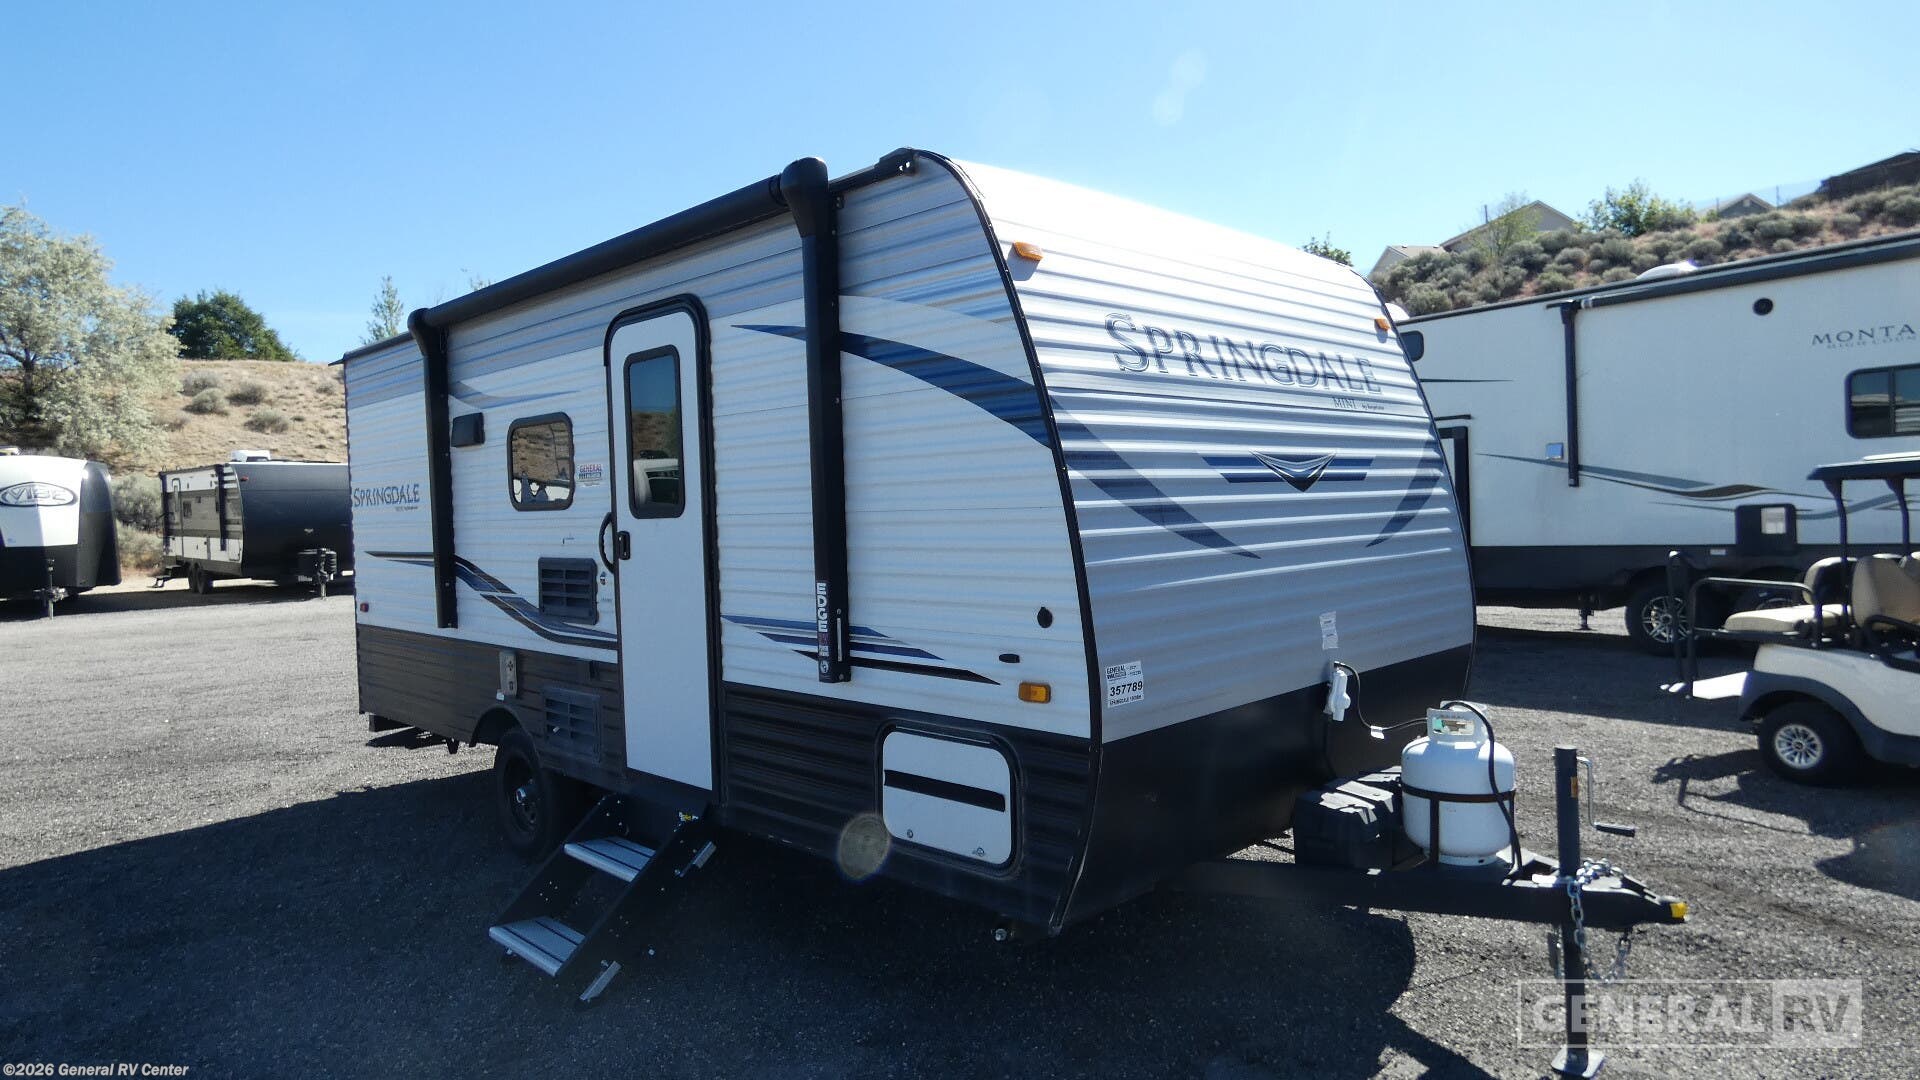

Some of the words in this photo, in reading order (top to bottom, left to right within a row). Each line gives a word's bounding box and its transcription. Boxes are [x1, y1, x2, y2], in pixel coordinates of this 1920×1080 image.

[1104, 312, 1383, 394] SPRINGDALE
[1332, 397, 1357, 409] MINI
[7, 485, 66, 501] VIBE
[353, 484, 420, 508] SPRINGDALE
[816, 582, 828, 633] EDGE
[1110, 680, 1143, 697] 357789
